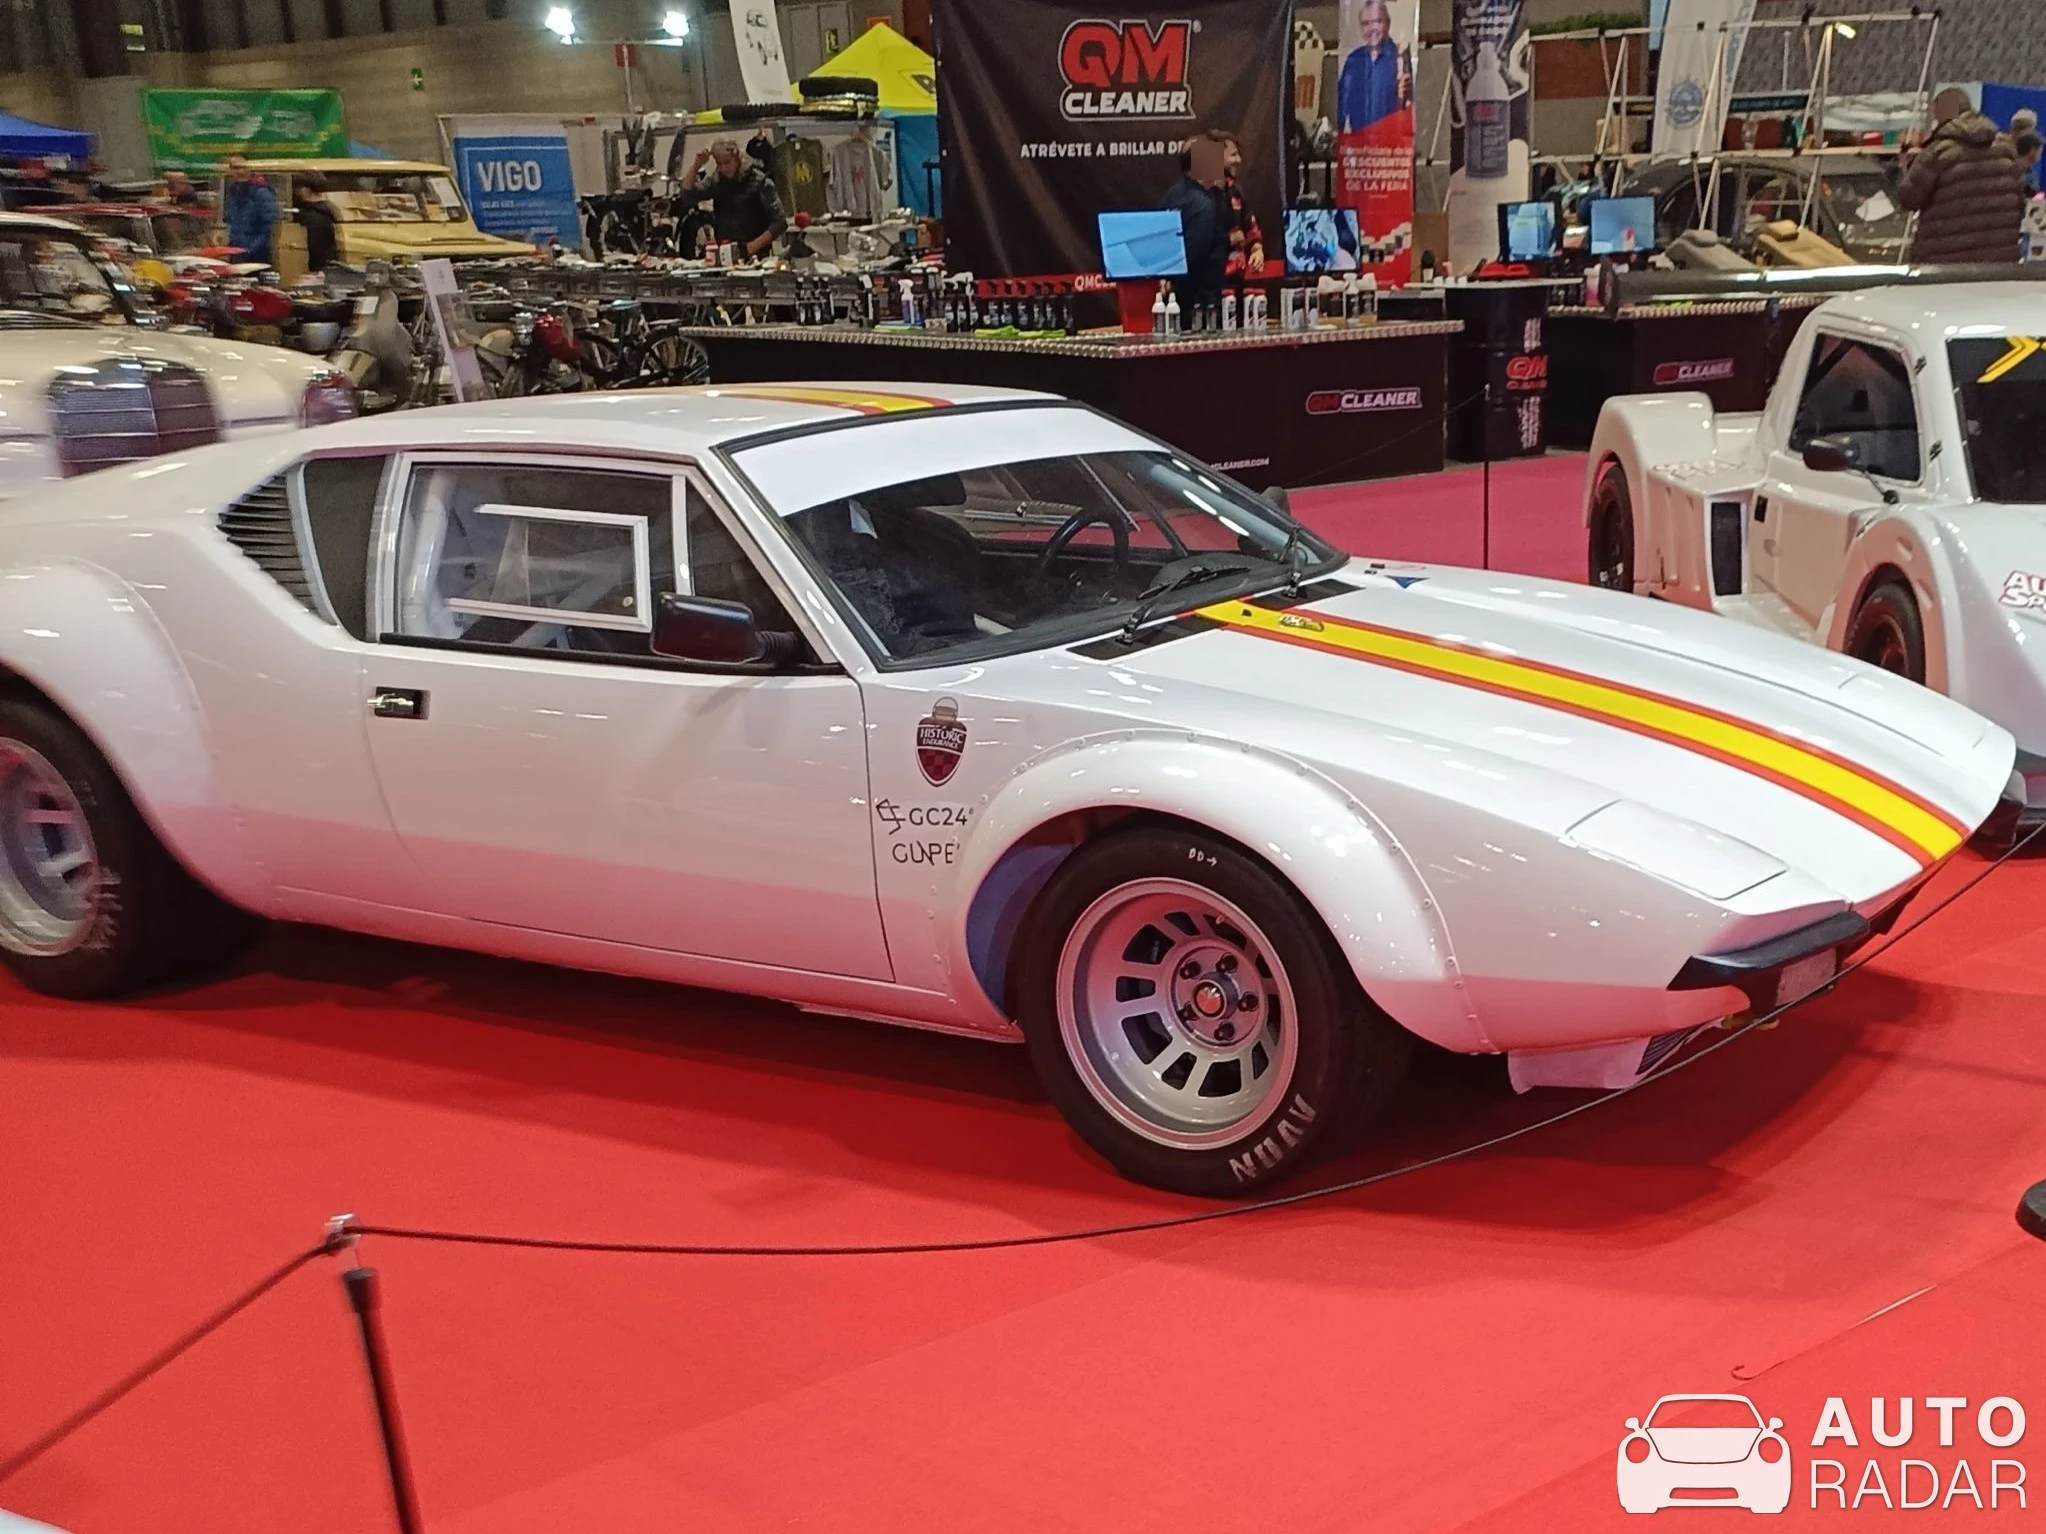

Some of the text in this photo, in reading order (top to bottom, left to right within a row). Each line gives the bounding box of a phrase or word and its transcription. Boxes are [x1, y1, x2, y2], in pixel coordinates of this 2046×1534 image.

[1062, 24, 1187, 87] QM
[1064, 91, 1187, 114] CLEANER
[1020, 140, 1092, 159] ATRÉVETE
[1096, 143, 1107, 157] A
[1109, 141, 1164, 156] BRILLAR
[476, 160, 543, 192] VIGO
[1341, 391, 1417, 409] CLEANER
[920, 728, 963, 744] HISTORIC
[1228, 1092, 1317, 1184] AVON
